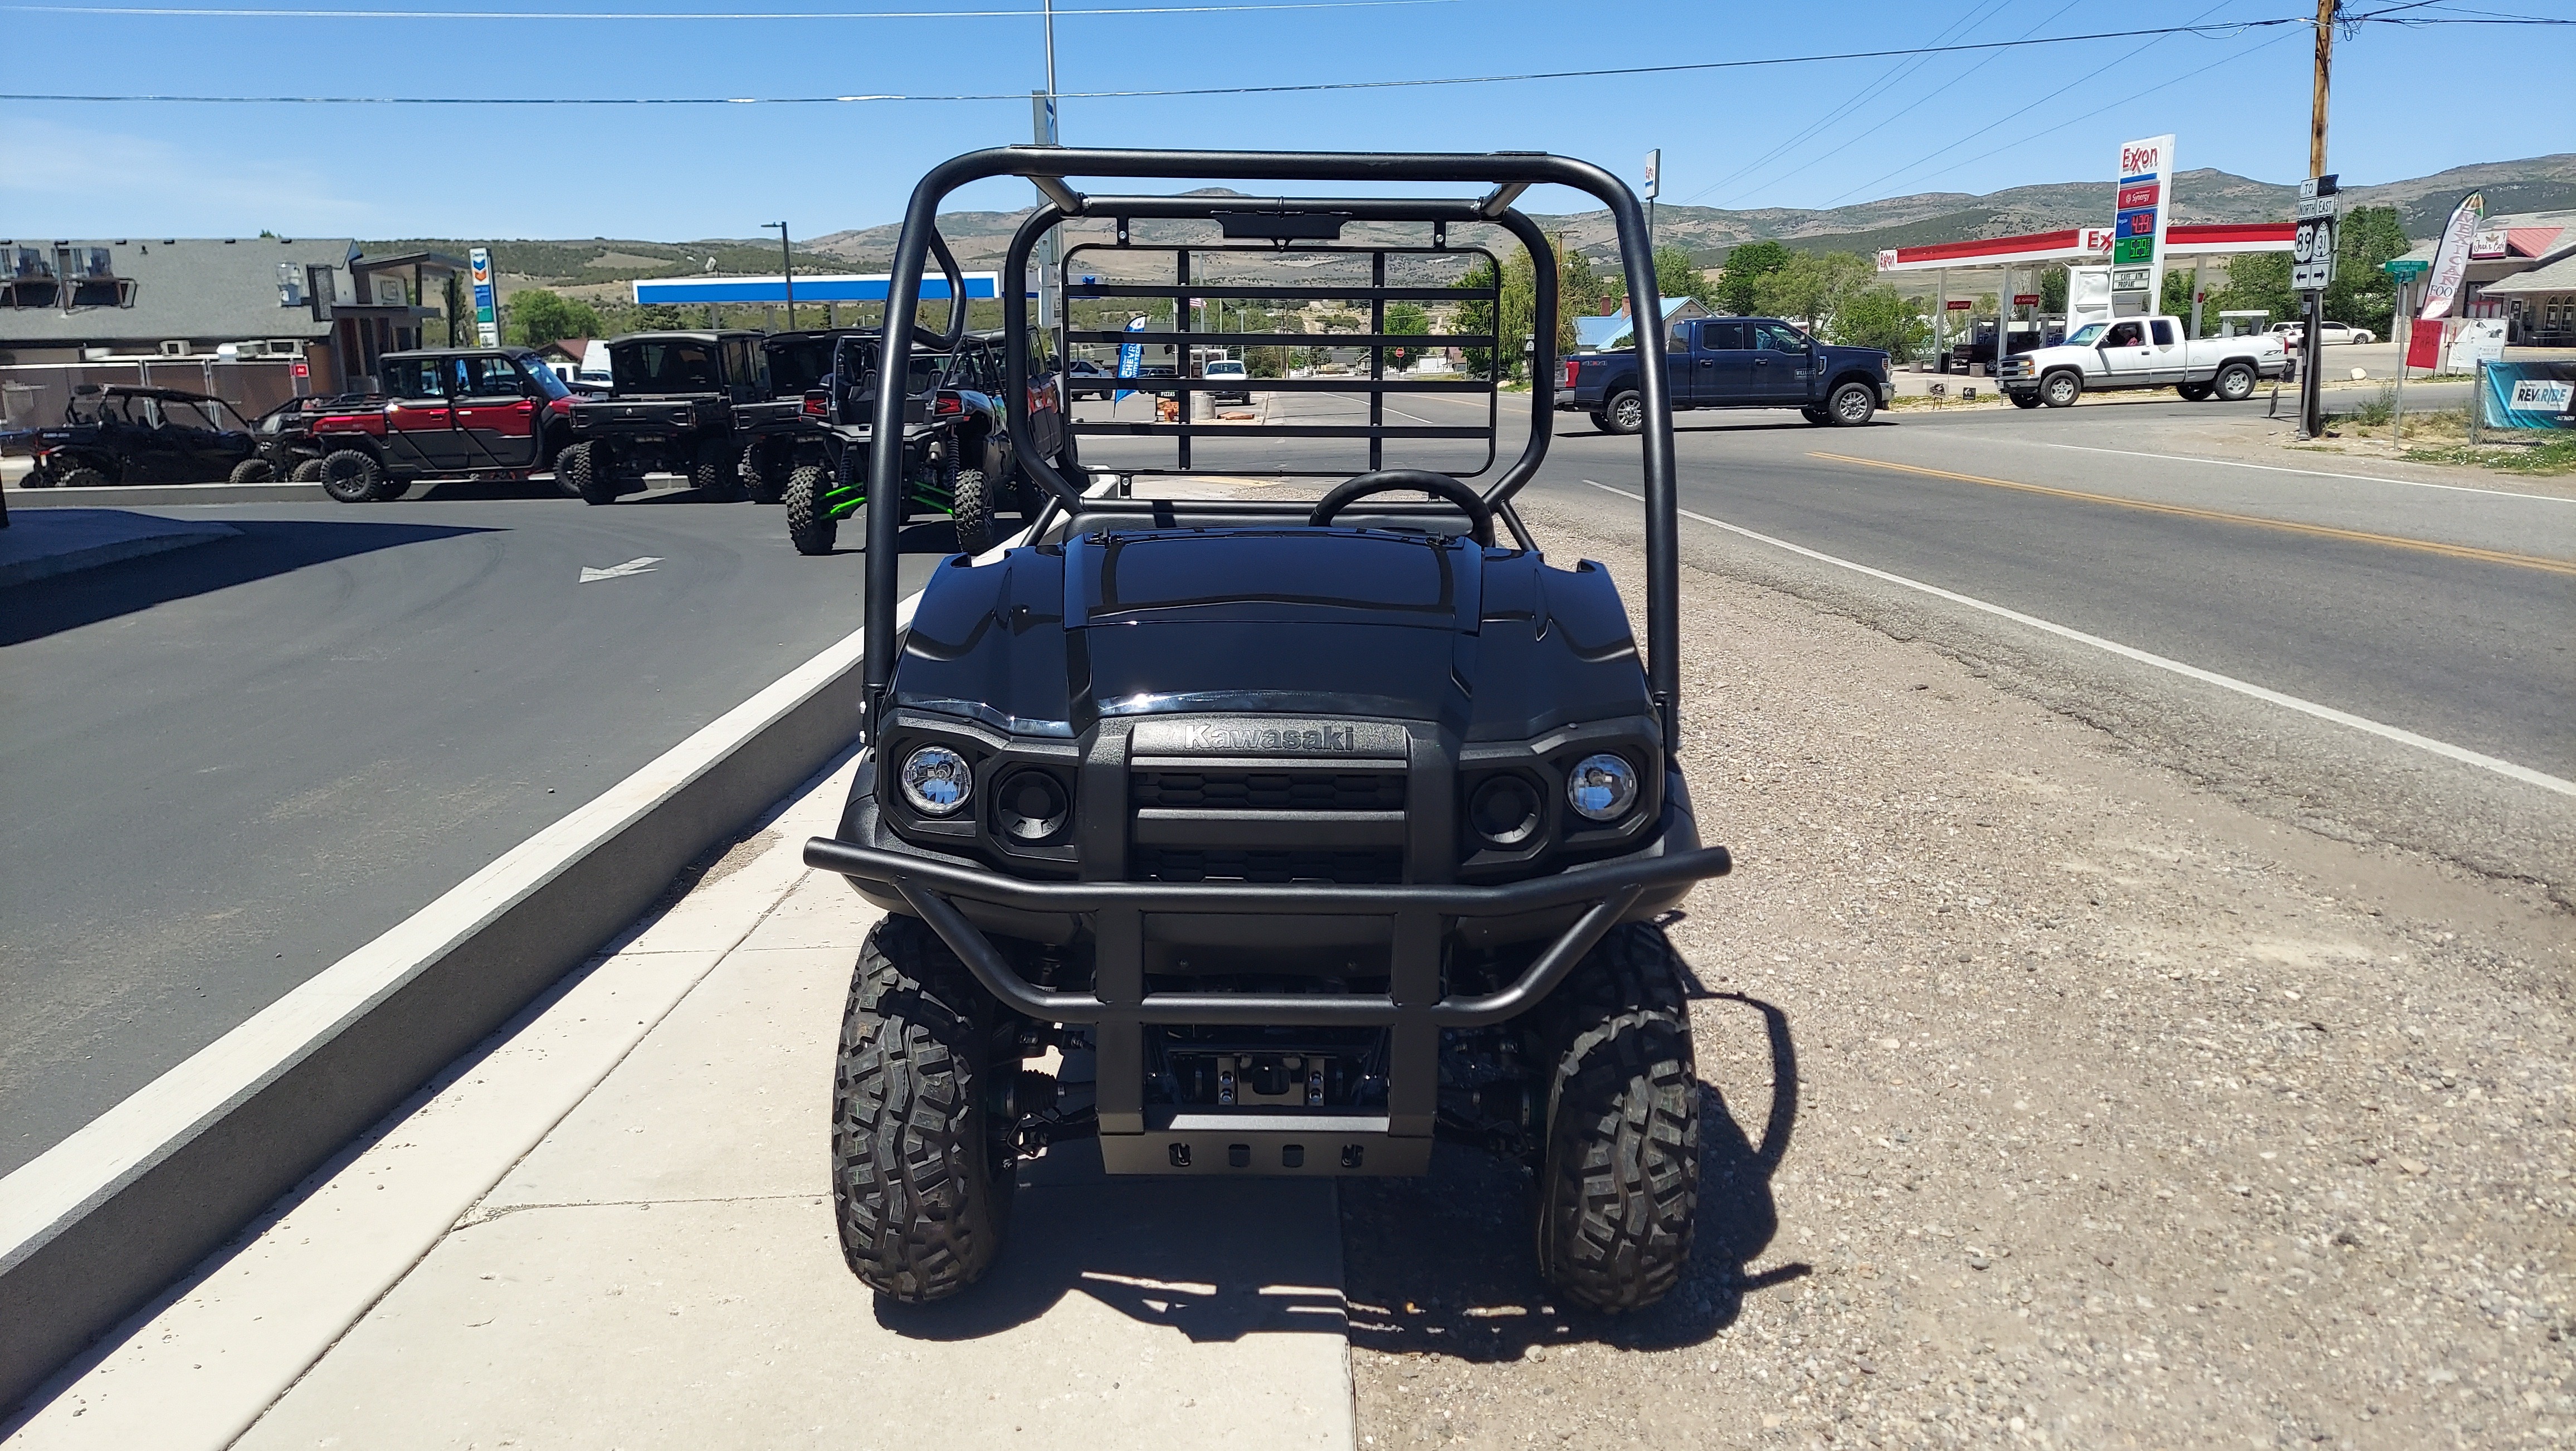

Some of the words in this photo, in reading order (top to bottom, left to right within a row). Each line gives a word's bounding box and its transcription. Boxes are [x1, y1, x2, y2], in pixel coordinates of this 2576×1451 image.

[2123, 147, 2158, 172] Exxon
[2305, 182, 2313, 194] TO
[2132, 193, 2150, 203] Synergy
[2299, 203, 2315, 216] NORTH
[2319, 200, 2332, 213] EAST
[2297, 232, 2311, 252] 89
[2318, 235, 2326, 250] 31
[2439, 211, 2475, 286] MEXICAN
[1185, 725, 1354, 751] Kawasaki
